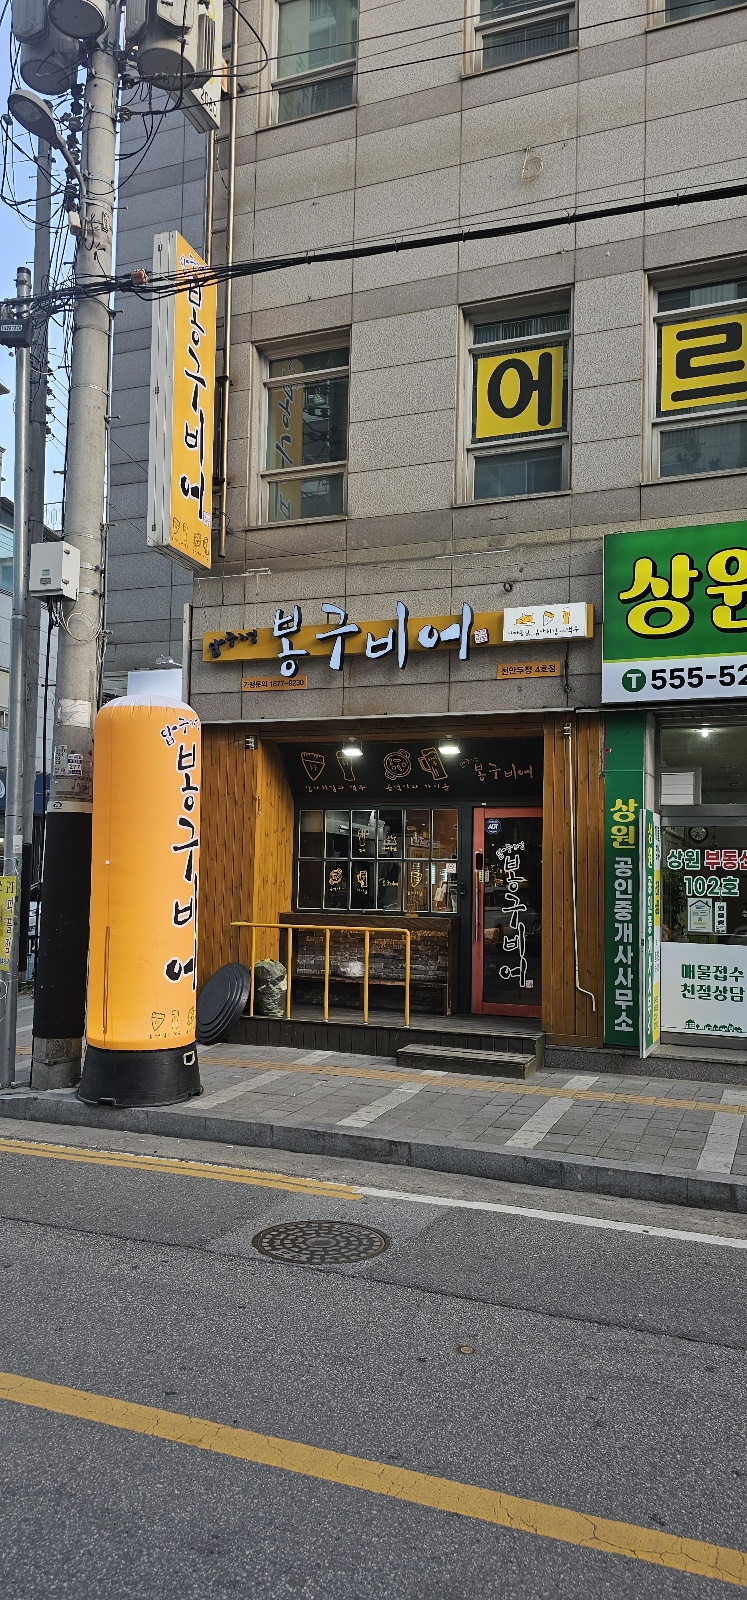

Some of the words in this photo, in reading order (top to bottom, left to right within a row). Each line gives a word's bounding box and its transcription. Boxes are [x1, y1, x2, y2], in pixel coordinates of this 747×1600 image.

[179, 273, 208, 521] 봉구비어
[208, 629, 257, 658] 압구정
[273, 601, 473, 677] 봉구비어
[501, 665, 532, 676] 천안두정
[534, 664, 556, 673] 4호점
[474, 763, 533, 781] 봉구비어
[610, 798, 638, 849] 상원
[164, 743, 200, 991] 봉구비어
[667, 849, 700, 870] 상원
[684, 876, 739, 896] 102호
[499, 854, 528, 988] 봉구비어
[614, 857, 634, 1032] 공인중개사사무소
[681, 963, 744, 983] 매물접수
[680, 982, 746, 1003] 친절상담
